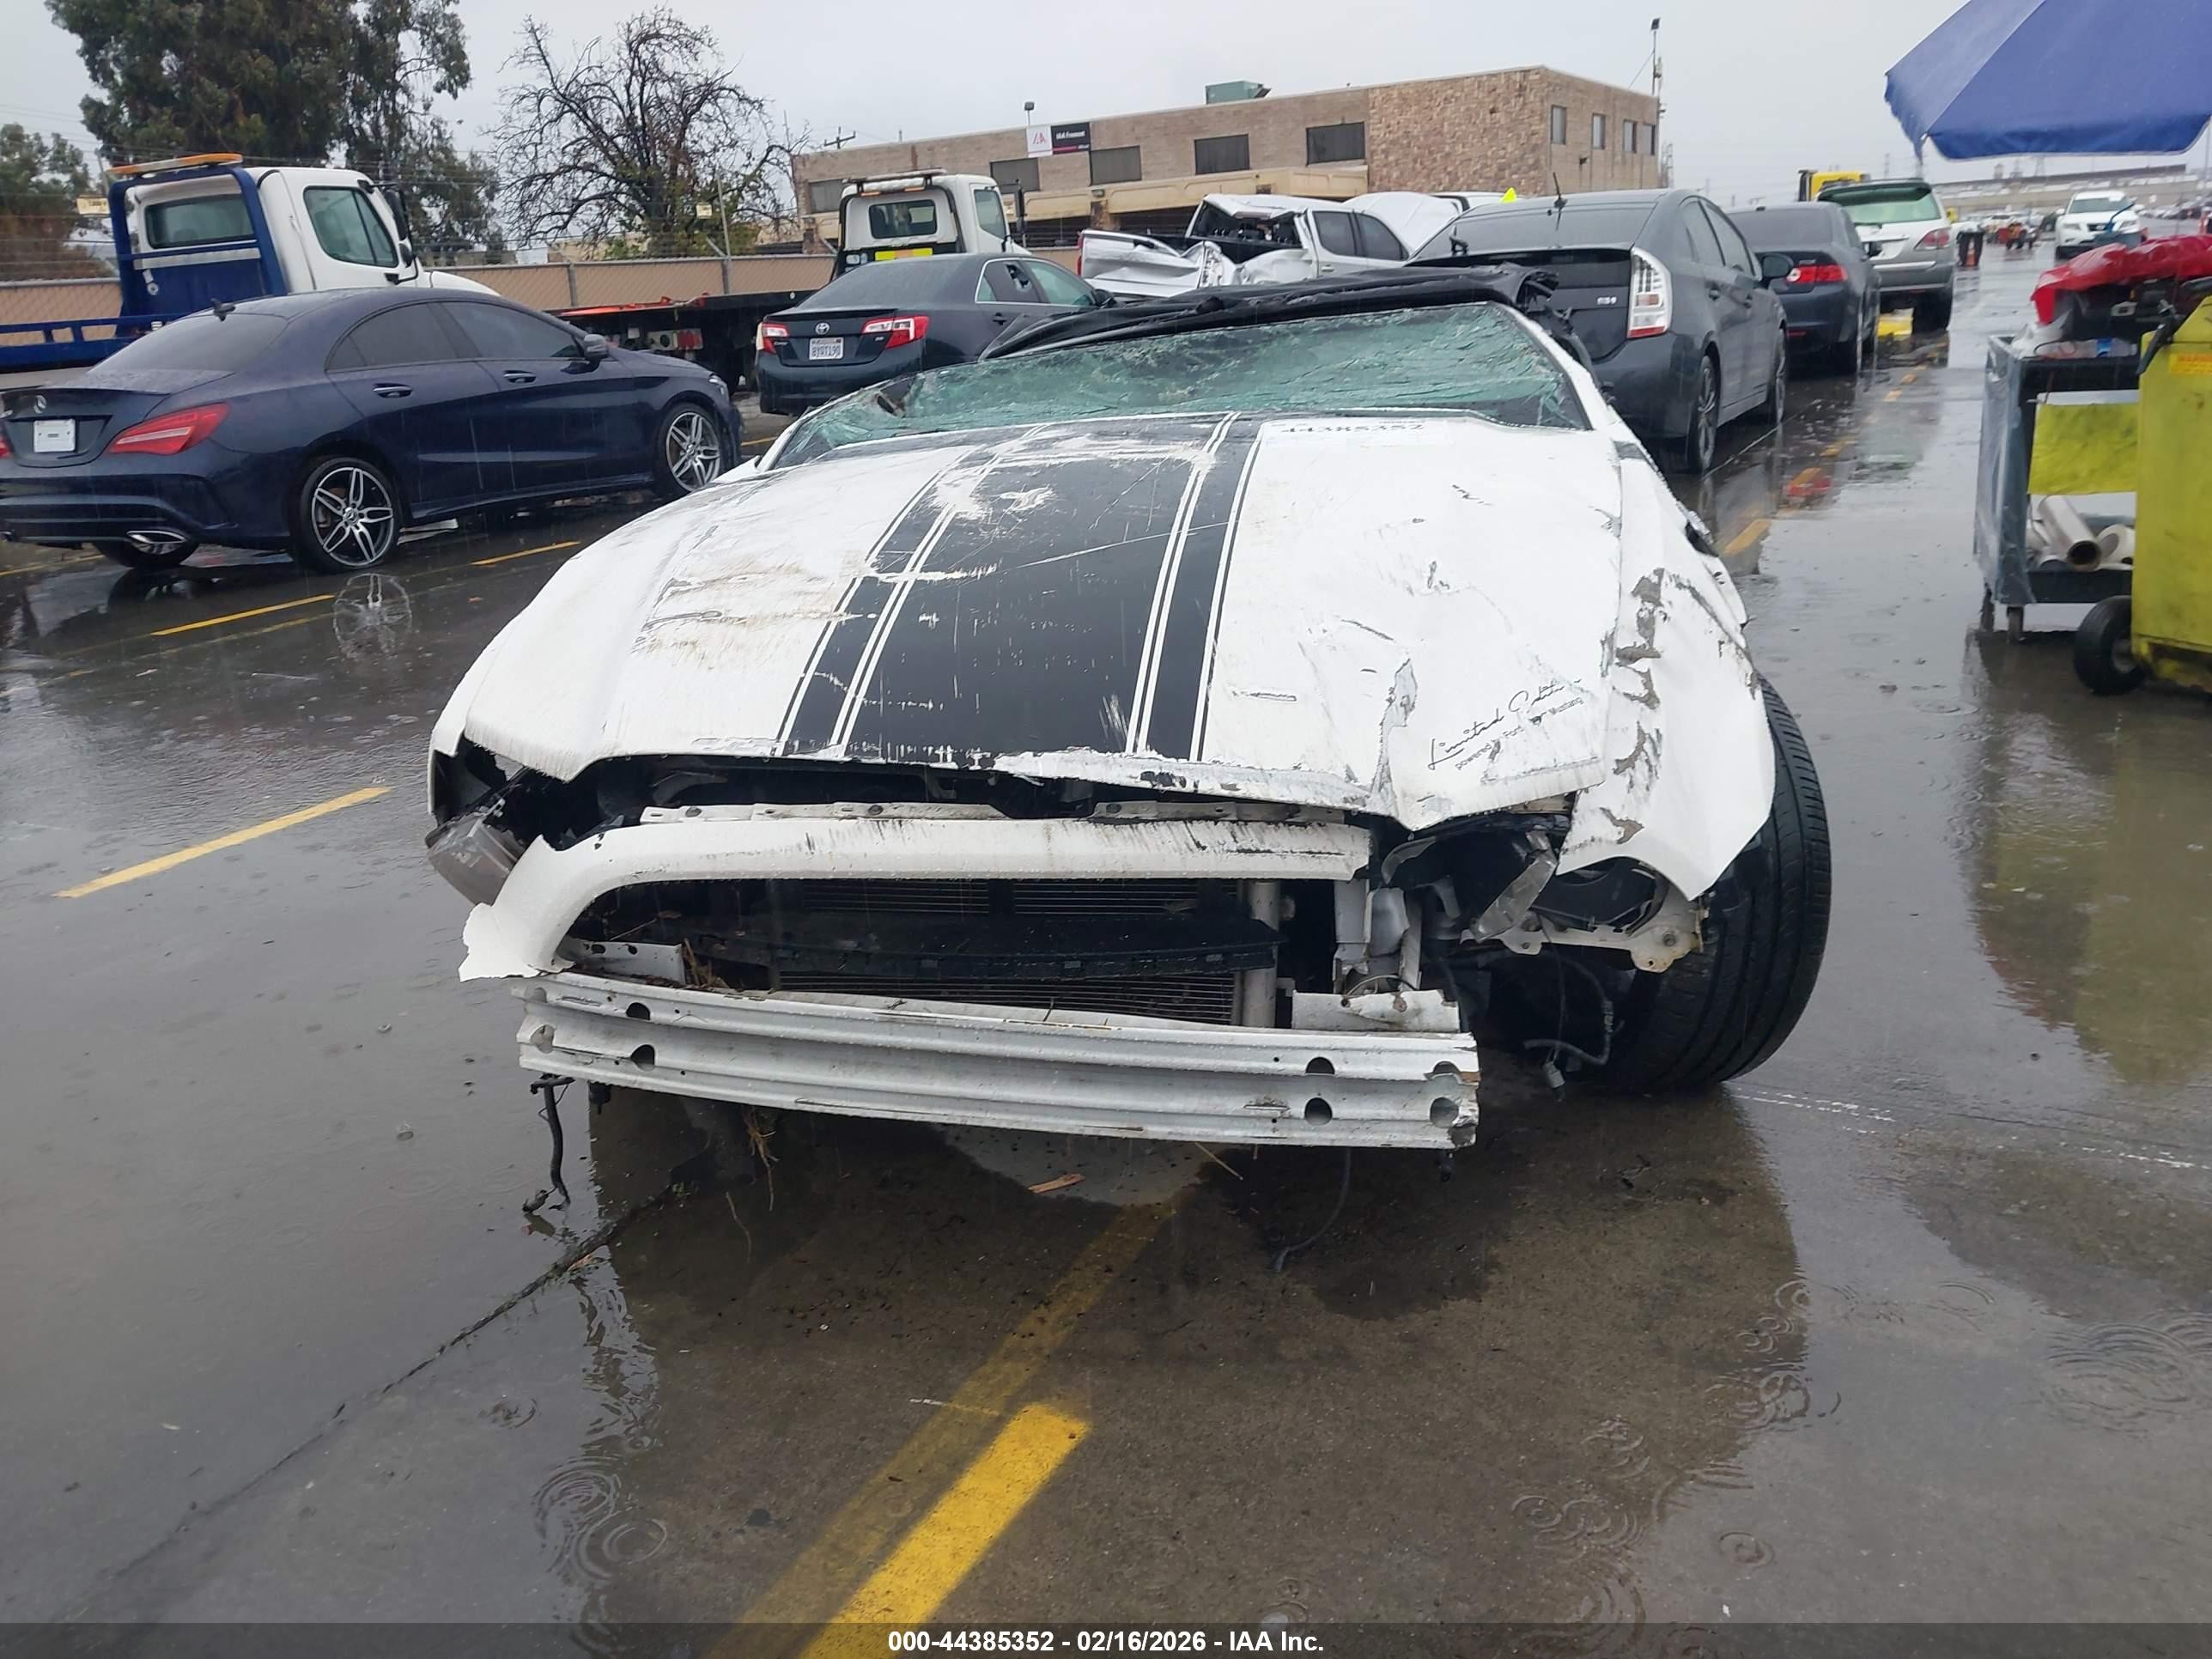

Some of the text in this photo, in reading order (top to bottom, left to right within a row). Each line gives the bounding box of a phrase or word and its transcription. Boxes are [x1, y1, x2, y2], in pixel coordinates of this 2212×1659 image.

[1428, 708, 1504, 770] Limited
[1509, 678, 1582, 713] Editio
[1548, 697, 1585, 715] Mustang
